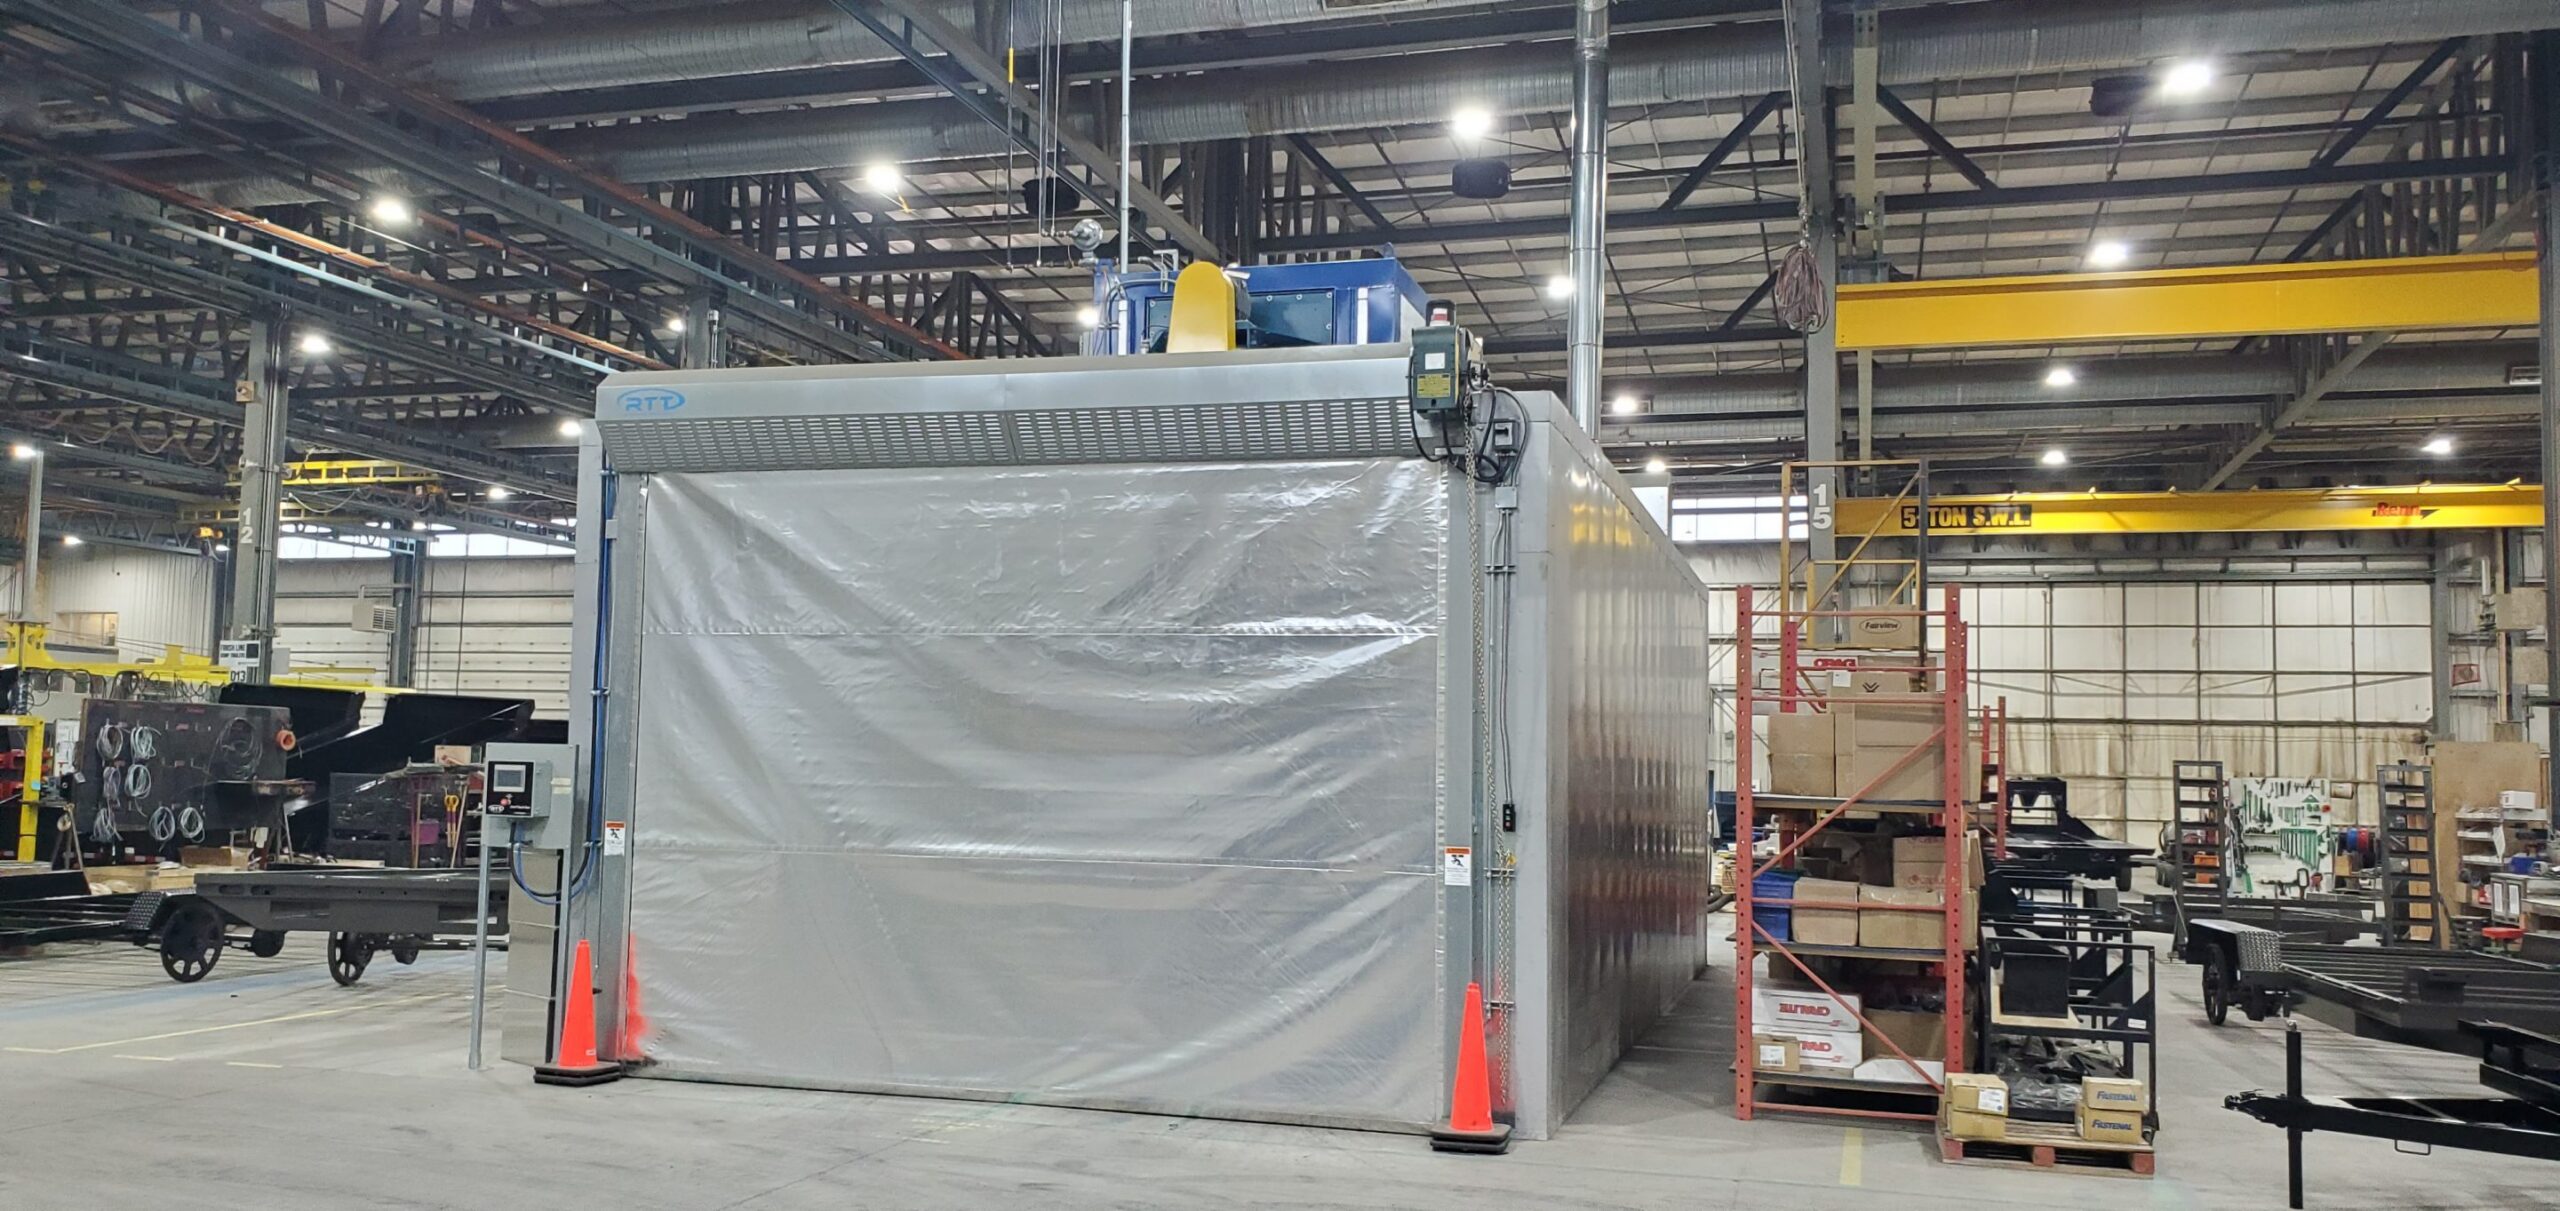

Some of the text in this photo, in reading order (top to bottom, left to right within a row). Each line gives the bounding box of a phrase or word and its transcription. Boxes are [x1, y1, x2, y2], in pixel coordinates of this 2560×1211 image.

[623, 394, 684, 412] RTT
[241, 507, 253, 544] 12
[1972, 506, 2031, 526] S.W.L.
